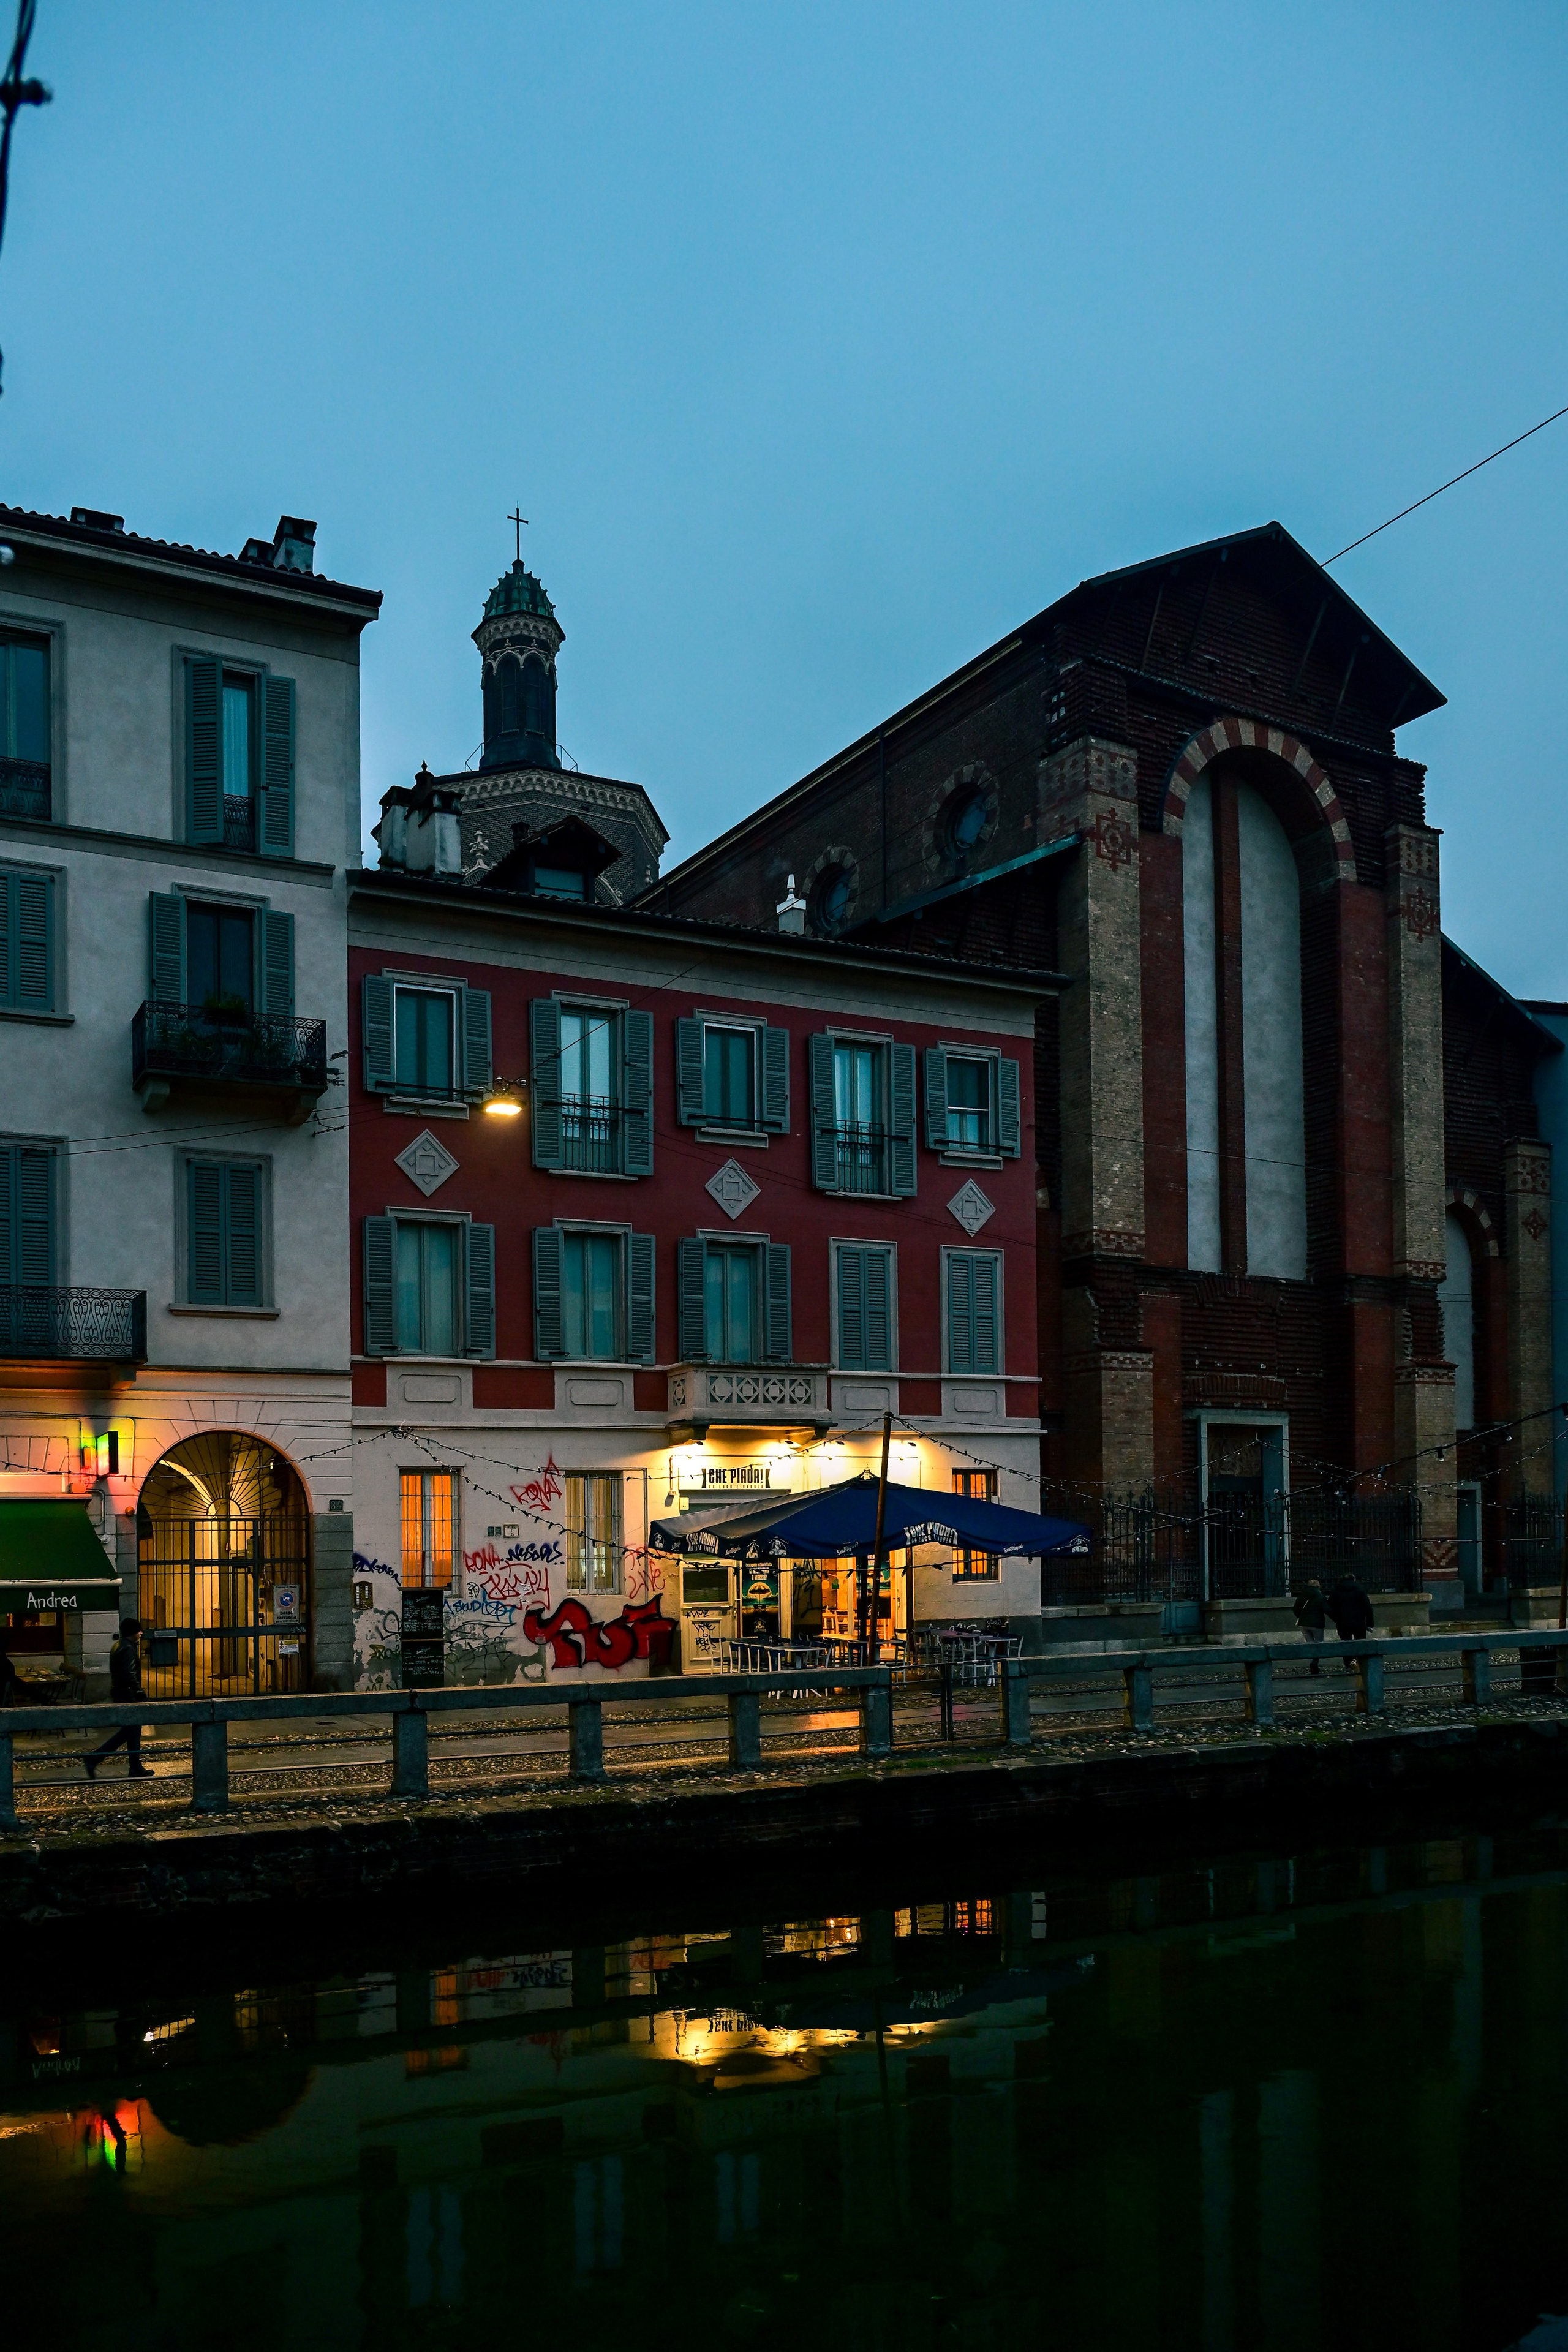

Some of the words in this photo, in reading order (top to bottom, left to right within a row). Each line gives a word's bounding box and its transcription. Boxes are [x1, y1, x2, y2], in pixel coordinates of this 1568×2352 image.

[709, 1469, 727, 1483] CHE
[730, 1469, 764, 1483] PIADA!
[26, 1591, 78, 1608] Andrea
